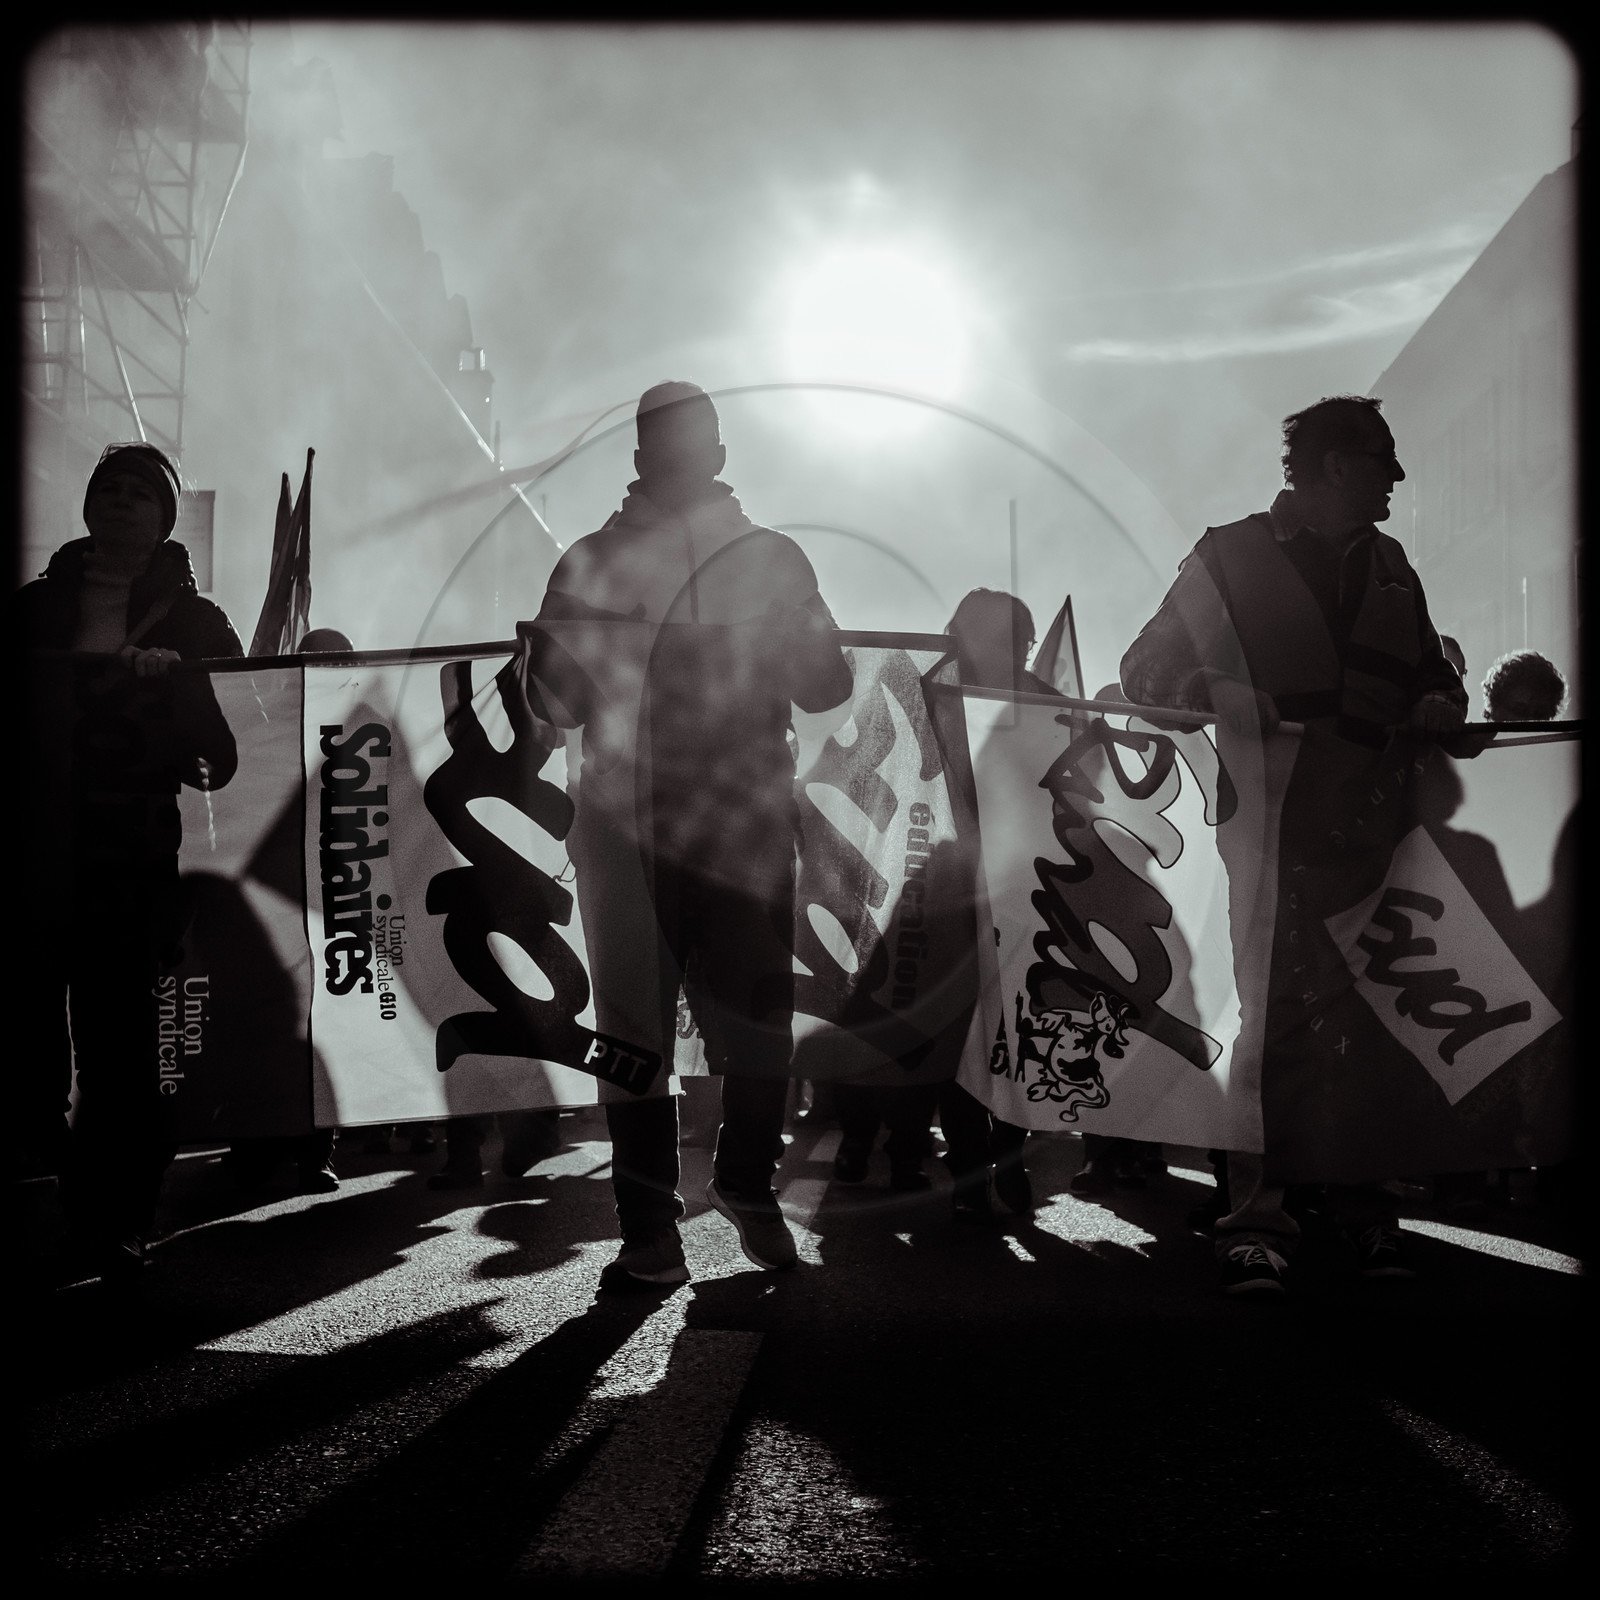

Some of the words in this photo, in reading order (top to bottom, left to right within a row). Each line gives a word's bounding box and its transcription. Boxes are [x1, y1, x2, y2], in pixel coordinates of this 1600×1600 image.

[318, 722, 392, 997] Solidaires
[388, 914, 405, 967] Union
[891, 800, 935, 1011] éducation
[374, 914, 394, 992] syndicale
[1356, 886, 1533, 1068] Sud
[151, 974, 183, 1095] syndicale
[182, 974, 211, 1056] Union
[378, 991, 398, 1021] G10
[583, 1037, 648, 1083] PTT
